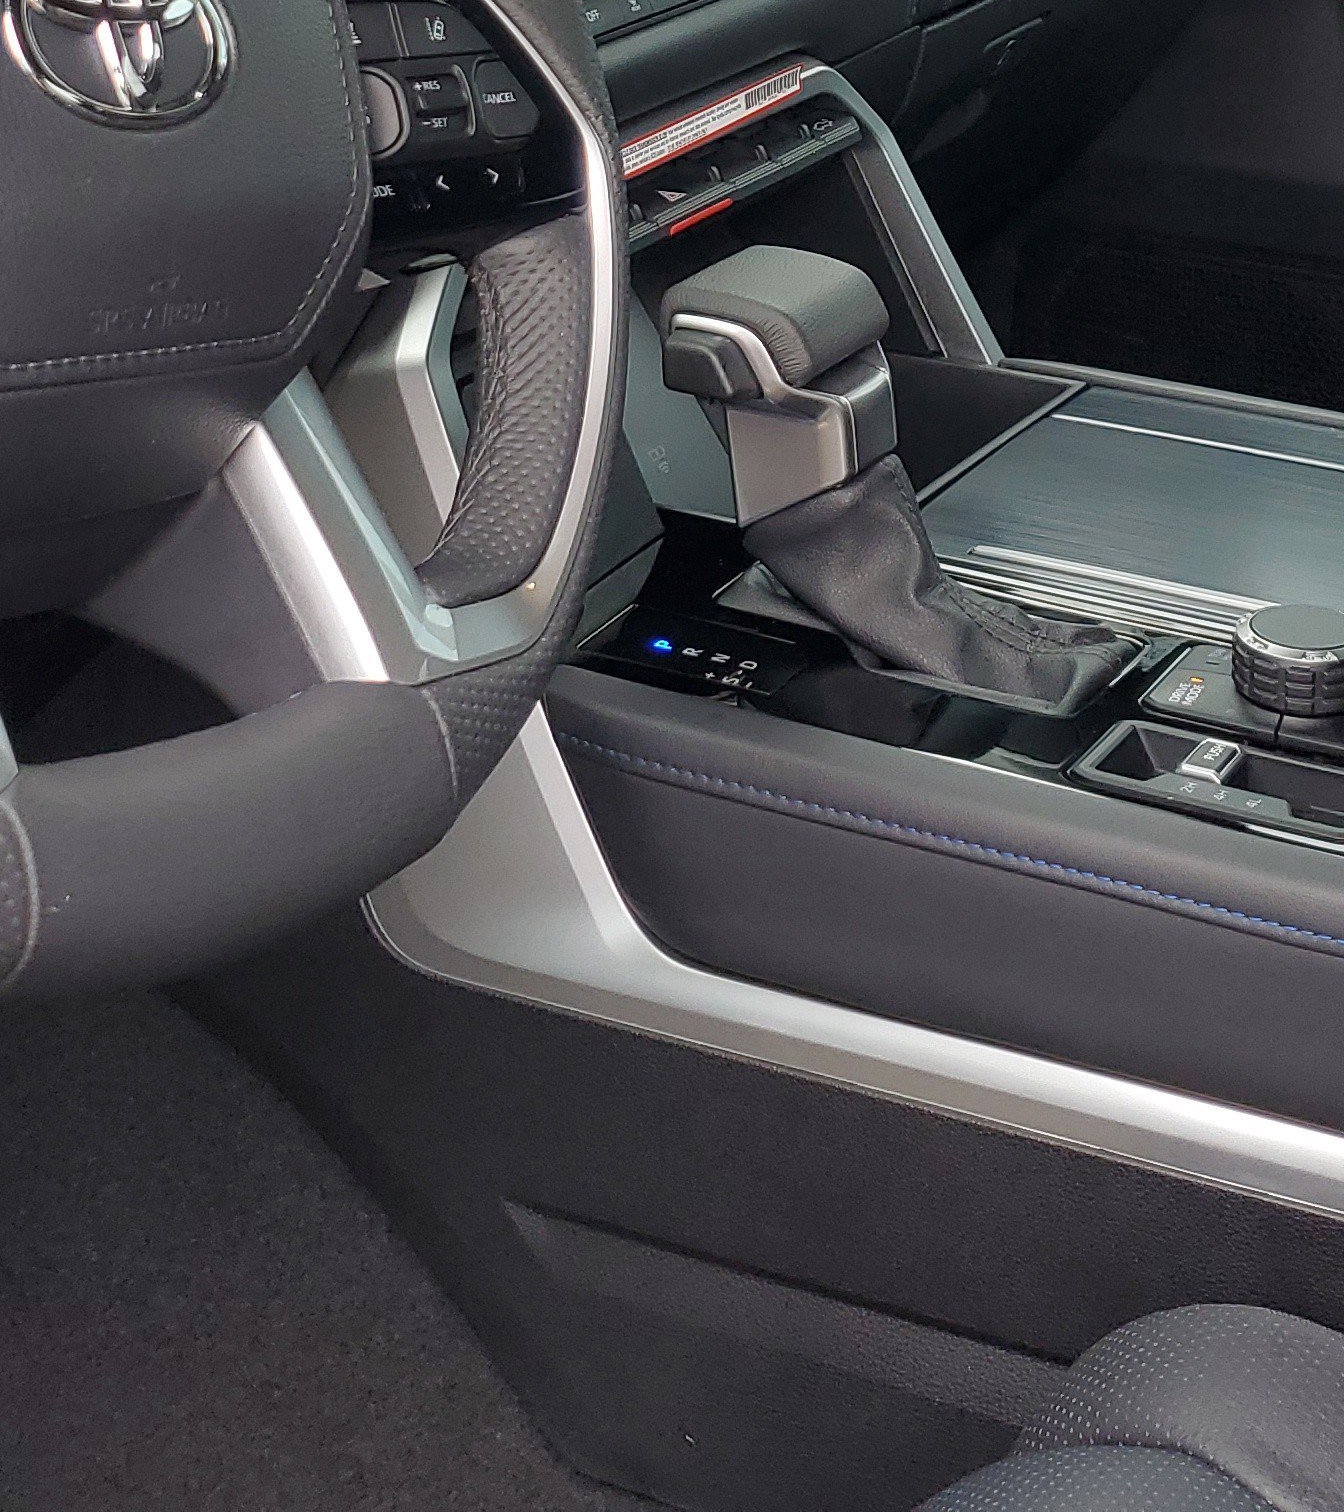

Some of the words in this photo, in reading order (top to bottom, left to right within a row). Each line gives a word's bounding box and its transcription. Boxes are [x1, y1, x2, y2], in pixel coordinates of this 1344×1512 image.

[585, 9, 601, 23] OFF
[482, 91, 516, 104] CANCEL
[653, 639, 673, 650] P
[682, 647, 705, 657] R
[711, 652, 731, 663] N
[739, 660, 758, 670] D
[721, 676, 740, 686] S
[1169, 682, 1191, 703] DRIVE
[1181, 684, 1205, 707] MODE
[1203, 743, 1228, 761] PUSH
[1180, 781, 1198, 794] 2H
